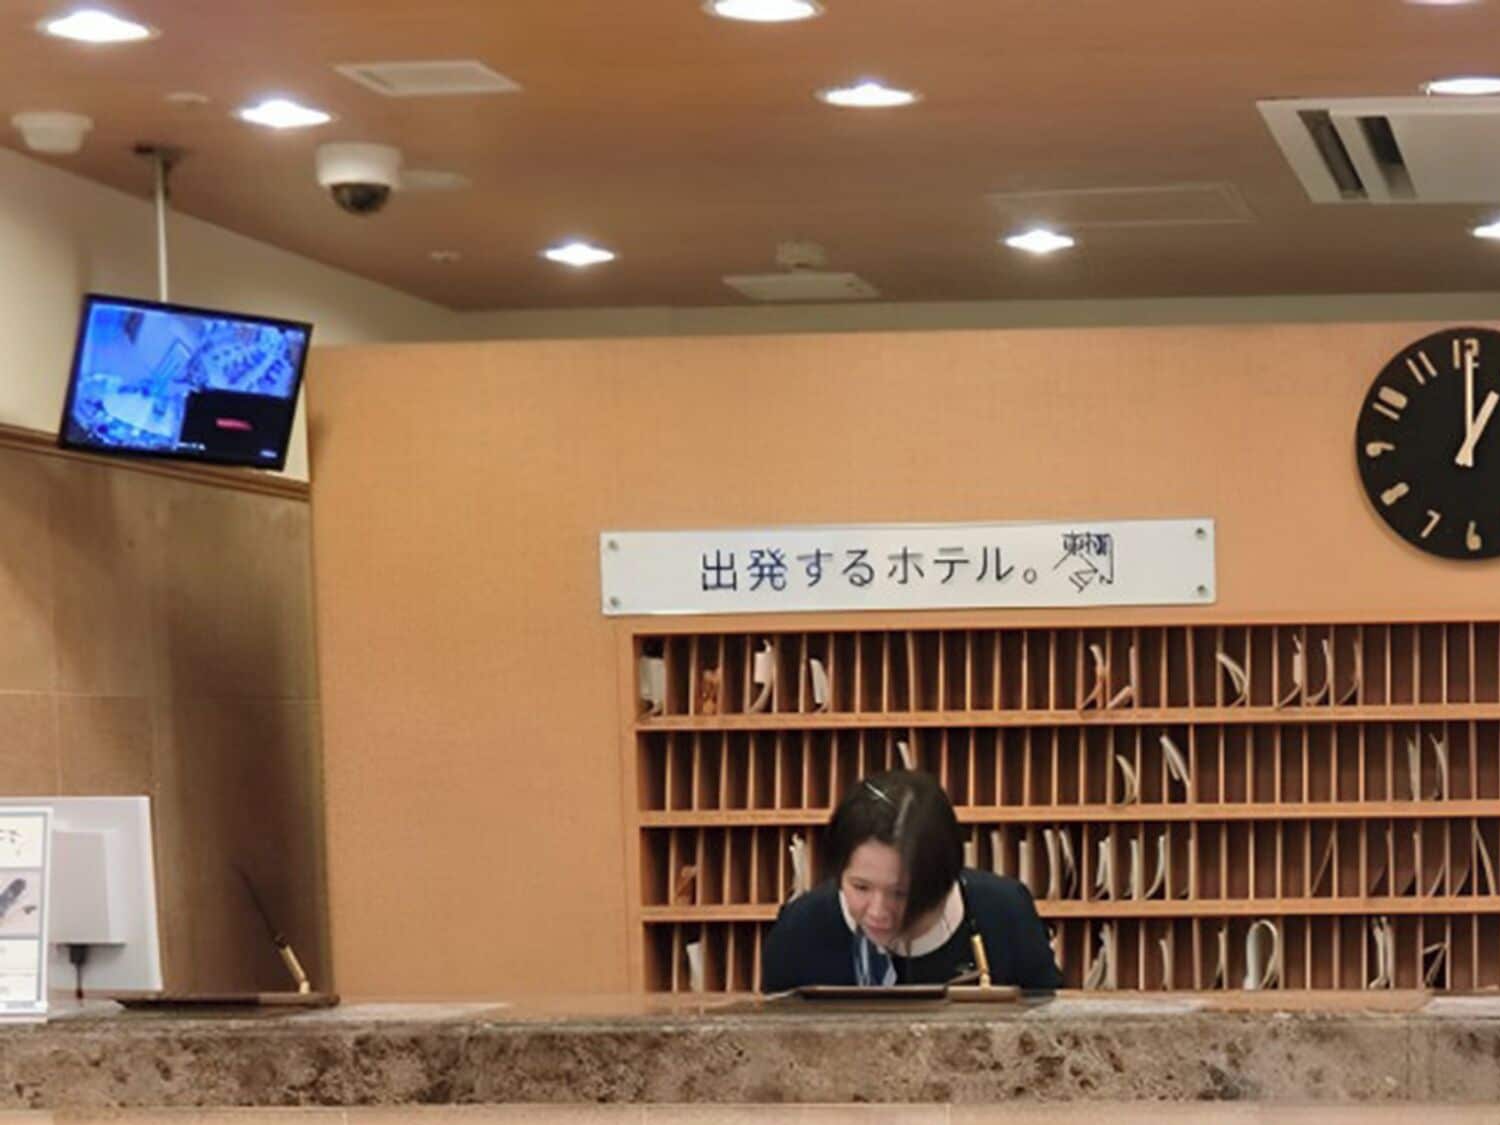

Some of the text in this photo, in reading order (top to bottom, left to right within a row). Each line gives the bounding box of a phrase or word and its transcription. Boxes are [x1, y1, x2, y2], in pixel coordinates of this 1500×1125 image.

[1406, 351, 1438, 385] 11
[1452, 338, 1480, 369] 12
[1372, 386, 1408, 421] 10
[1365, 442, 1395, 457] 9
[1380, 482, 1410, 506] 8
[1420, 509, 1442, 539] 7
[1466, 520, 1482, 551] 6
[700, 545, 1038, 593] 出発するホテル。
